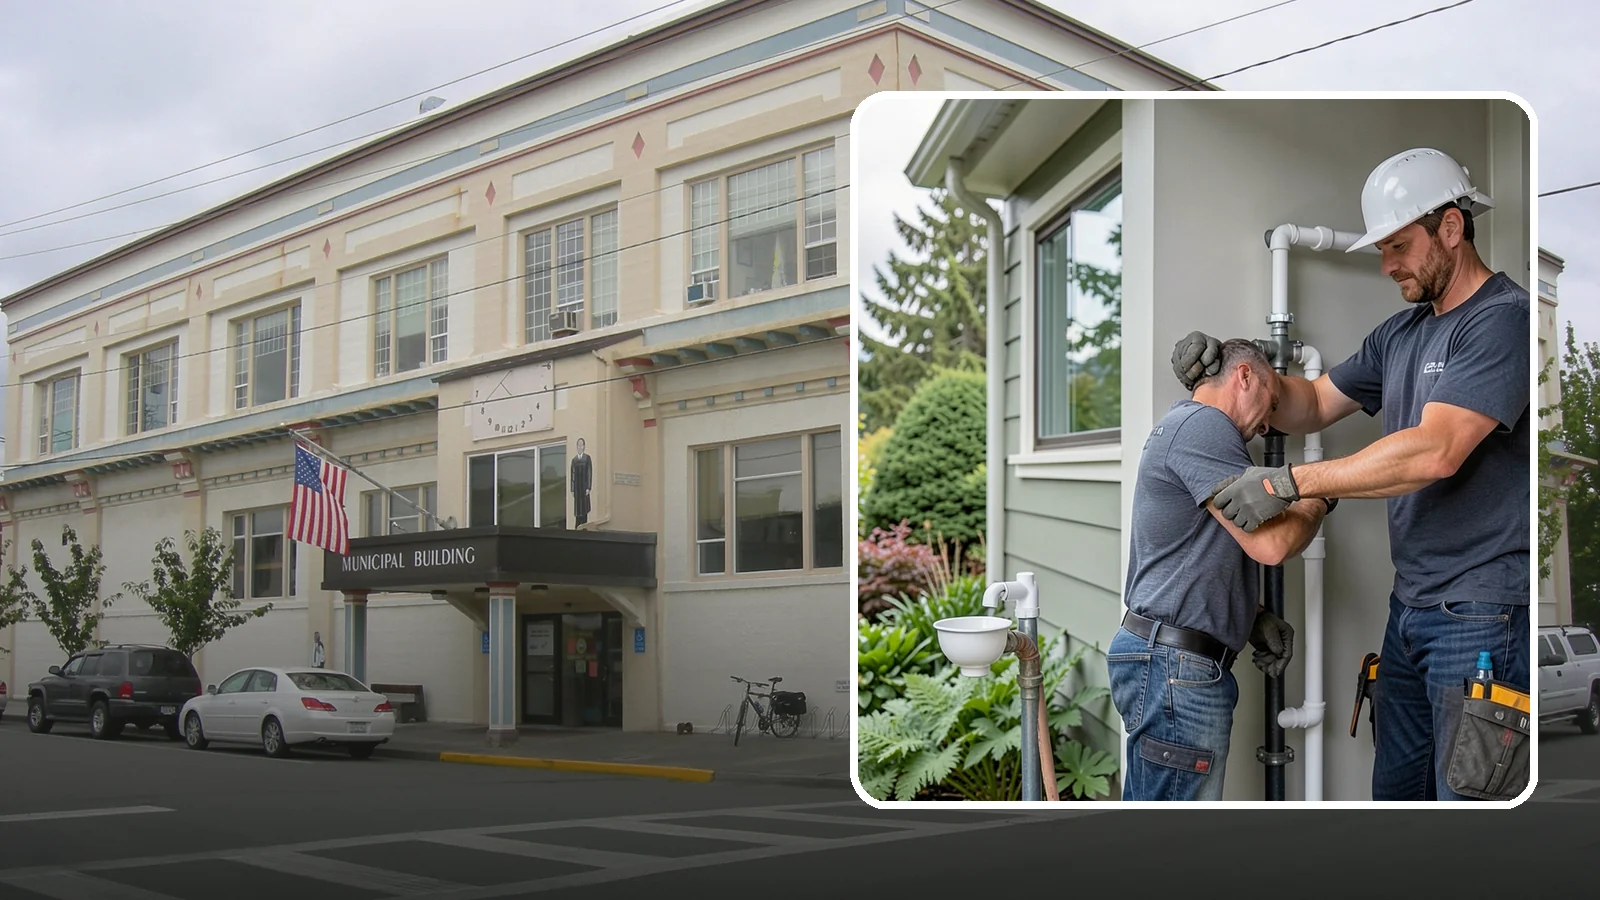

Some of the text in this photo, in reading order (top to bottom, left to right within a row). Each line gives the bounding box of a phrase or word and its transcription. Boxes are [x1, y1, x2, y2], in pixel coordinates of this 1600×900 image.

[536, 402, 540, 410] 4
[480, 407, 485, 415] 8
[488, 417, 492, 426] 9
[529, 414, 533, 422] 3
[494, 423, 500, 432] 10
[501, 425, 506, 433] 11
[507, 425, 514, 433] 12
[521, 420, 525, 428] 2
[342, 546, 475, 572] MUNICIPAL BUILDING
